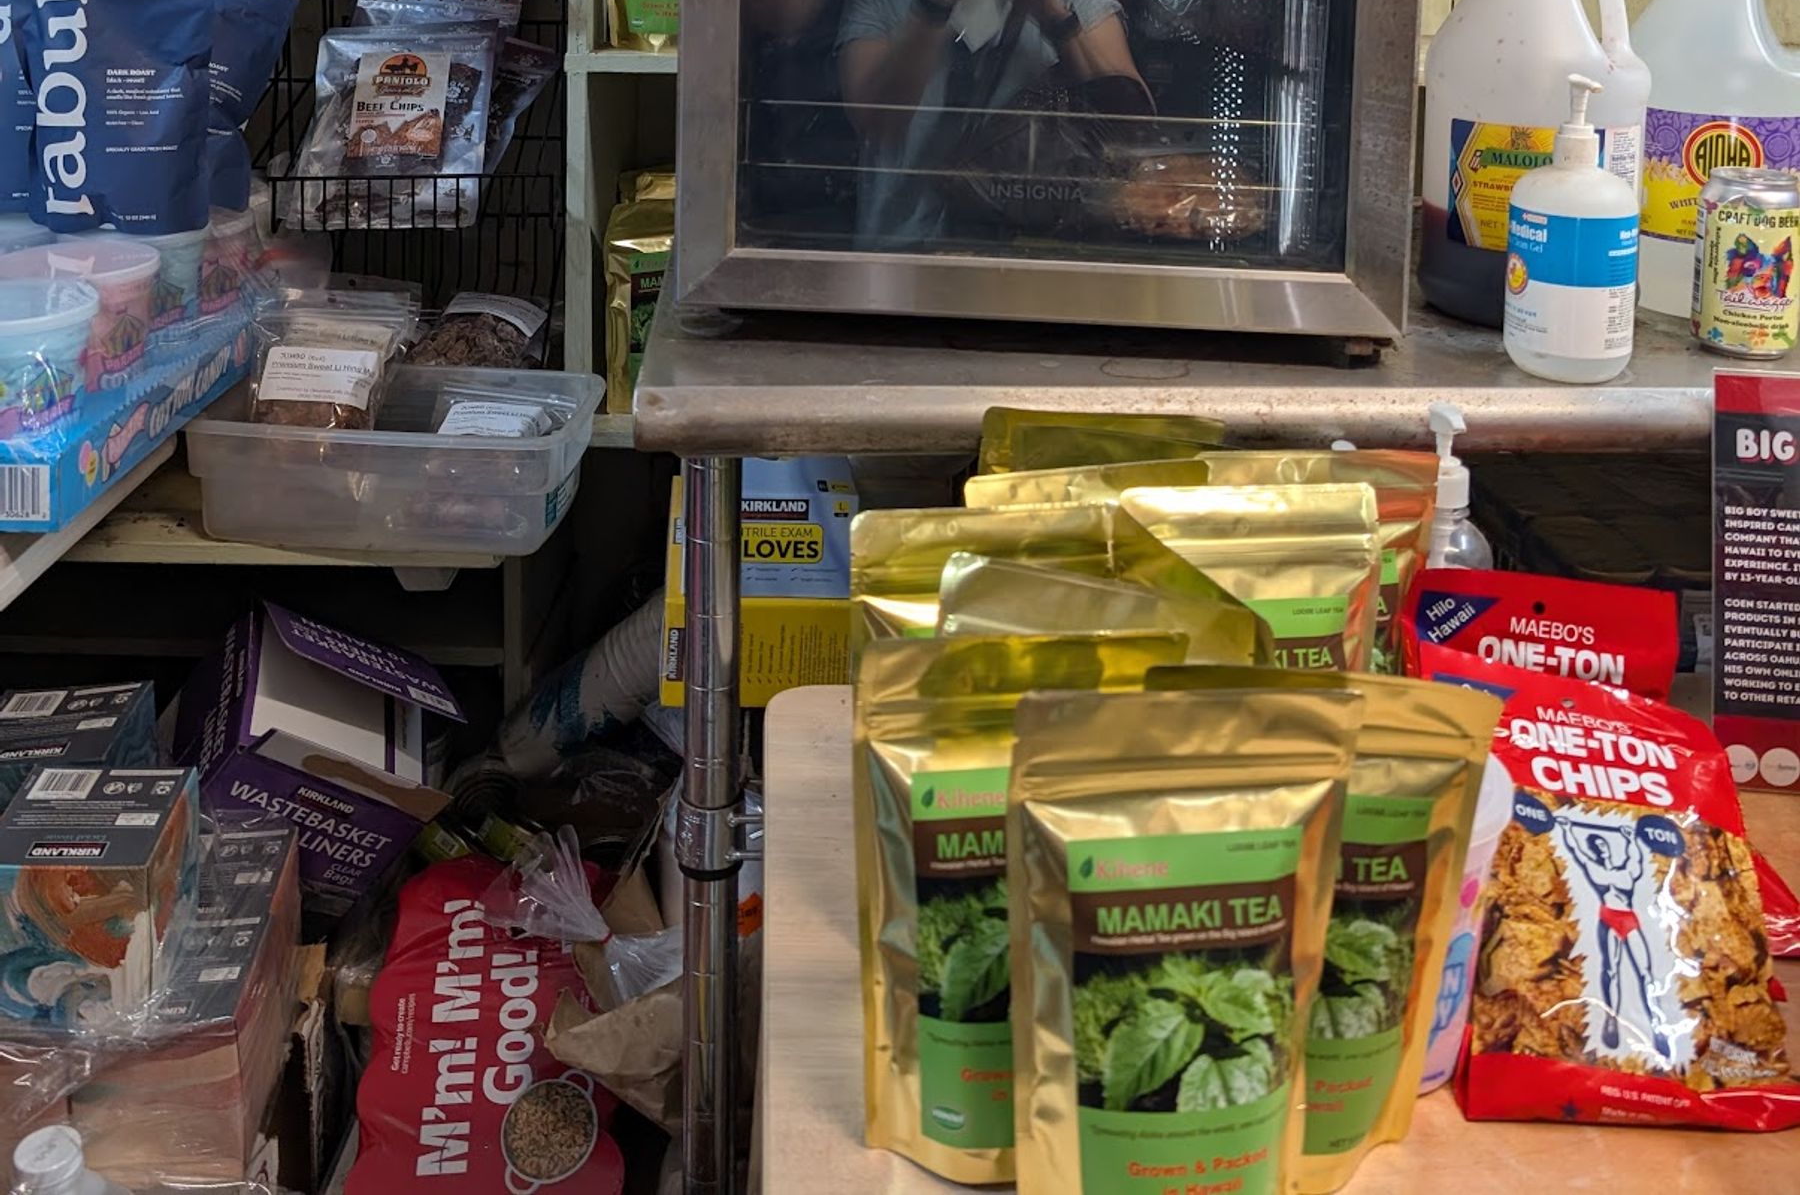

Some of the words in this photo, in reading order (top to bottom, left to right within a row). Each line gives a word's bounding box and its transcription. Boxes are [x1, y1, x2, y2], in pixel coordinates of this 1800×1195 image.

[106, 68, 129, 76] DARK
[374, 75, 429, 86] PANIOLO
[356, 101, 385, 112] BEEF
[389, 100, 424, 112] CHIPS
[1490, 152, 1553, 167] MALOLO
[1694, 133, 1751, 176] ALOHA
[990, 183, 1083, 202] INSIGNIA
[1717, 210, 1752, 226] CRAFT
[1753, 214, 1776, 228] DOG
[1778, 214, 1800, 229] BEER
[1713, 315, 1769, 330] Non-alcoholic
[1722, 308, 1757, 320] Chicken
[307, 364, 333, 372] Sweet
[1735, 428, 1796, 463] BIG
[741, 500, 808, 512] KIRKLAND
[1724, 506, 1745, 516] BIG
[1746, 507, 1768, 517] BOY
[780, 527, 814, 538] EXAM
[1724, 518, 1775, 532] INSPIRED
[1724, 532, 1778, 545] COMPANY
[743, 539, 819, 559] LOVES
[1724, 545, 1766, 557] HAWAII
[1767, 548, 1783, 558] TO
[1724, 558, 1791, 572] EXPERIENCE.
[1724, 572, 1738, 582] BY
[1425, 596, 1457, 622] Hilo
[1724, 597, 1755, 608] COEN
[1427, 602, 1478, 644] Hawaii
[1724, 611, 1781, 624] PRODUCTS
[1782, 613, 1795, 624] IN
[1510, 616, 1595, 645] MAEBO'S
[1724, 624, 1788, 638] EVENTUALLY
[1724, 638, 1794, 652] PARTICIPATE
[668, 629, 680, 679] KIRKLAND
[1292, 646, 1334, 668] TEA
[1477, 635, 1625, 685] ONE-TON
[1724, 651, 1768, 663] ACROSS
[1724, 665, 1743, 674] HIS
[1745, 666, 1771, 676] OWN
[1724, 677, 1777, 690] WORKING
[1778, 680, 1793, 691] TO
[1723, 691, 1738, 701] TO
[1740, 692, 1775, 703] OTHER
[1536, 705, 1632, 736] MAEBO'S
[1510, 717, 1679, 771] ONE-TON
[1531, 756, 1675, 807] CHIPS
[297, 786, 355, 815] KIRKLAND
[229, 779, 393, 851] WASTEBASKET
[1514, 805, 1548, 823] ONE
[1643, 826, 1679, 845] TON
[31, 847, 102, 857] KIRKLAND
[298, 830, 377, 868] LINERS
[936, 829, 1004, 860] MAM
[331, 862, 363, 878] CLEAR
[1352, 855, 1409, 882] TEA
[322, 869, 355, 886] Bags
[1096, 899, 1223, 935] MAMAKI
[1228, 894, 1284, 926] TEA
[431, 898, 487, 1023] M'm!
[397, 997, 406, 1022] create
[481, 949, 539, 1105] Good!
[415, 1037, 479, 1178] M'm!
[1195, 1160, 1207, 1175] &
